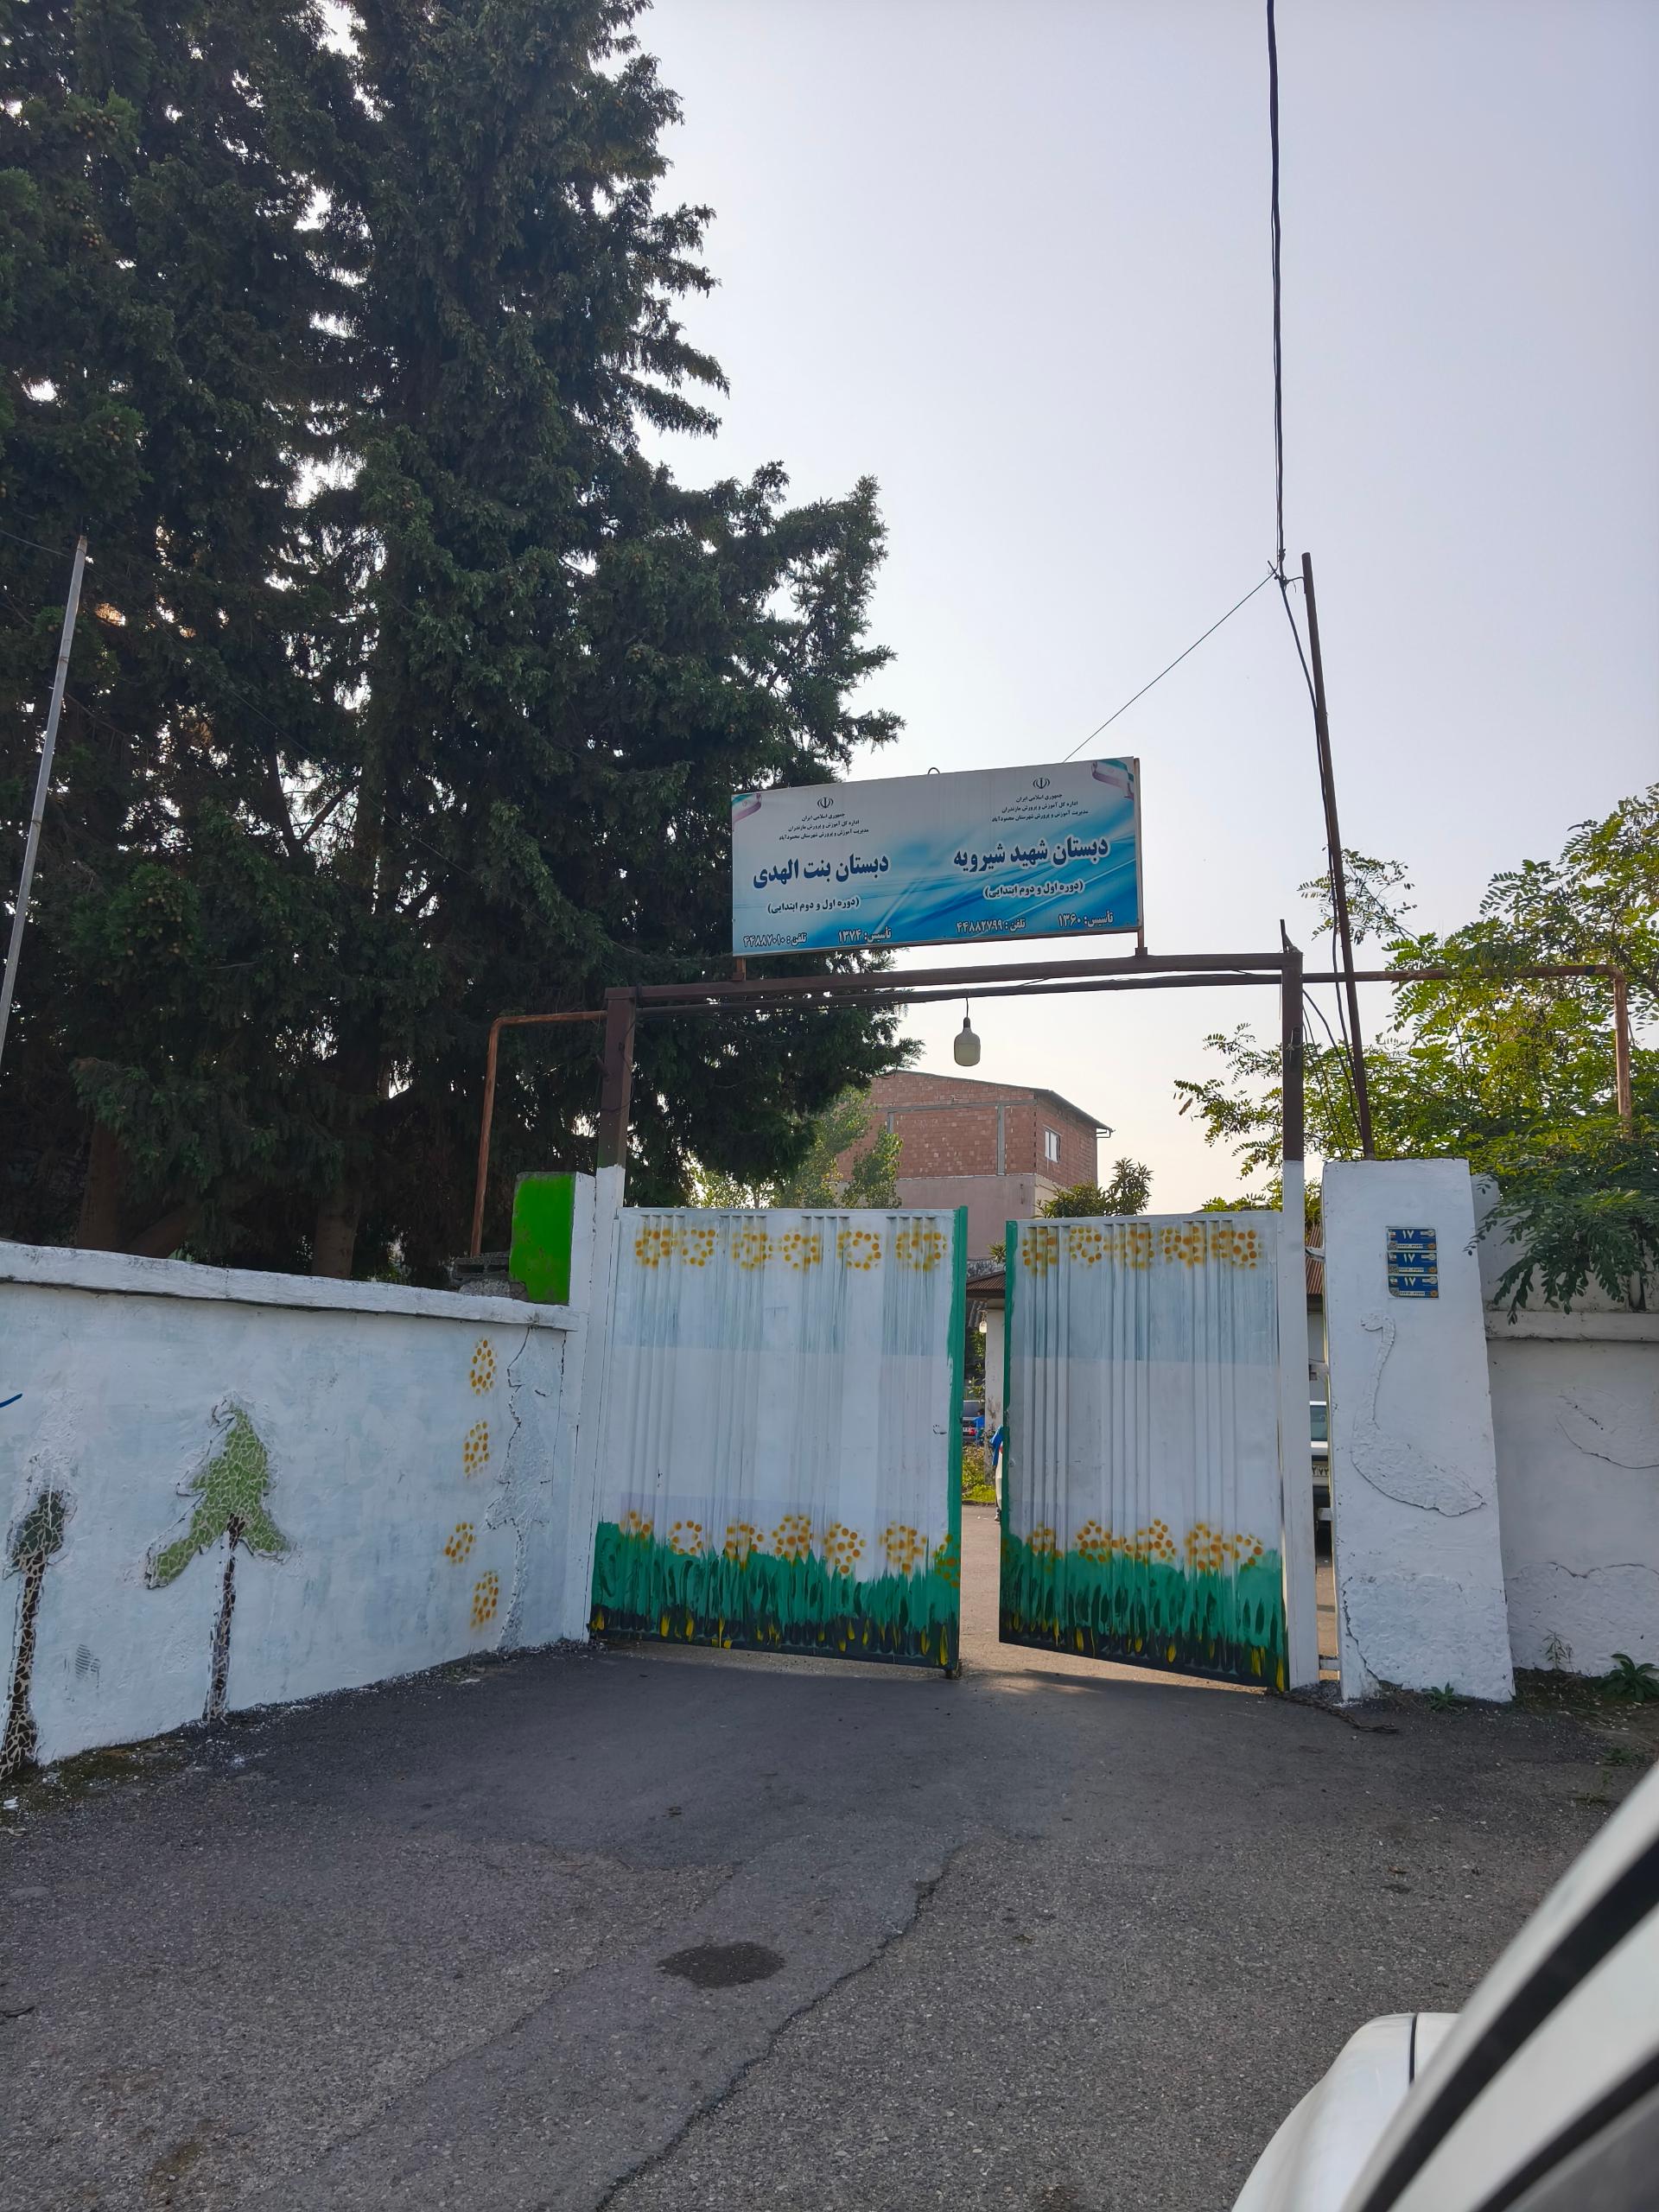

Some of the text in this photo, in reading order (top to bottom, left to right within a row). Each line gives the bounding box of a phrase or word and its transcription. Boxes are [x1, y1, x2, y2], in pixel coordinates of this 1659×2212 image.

[1041, 801, 1058, 810] آموزش
[1054, 810, 1071, 818] آموزش
[953, 836, 1109, 873] دبستان شهید شیرویه
[753, 853, 889, 889] دبستان بنت الهدی
[984, 880, 1084, 899] (دوره اول و دوم ابتدایی)
[767, 901, 798, 914] ابتدایی)
[799, 901, 814, 912] دوم
[822, 899, 836, 910] اول
[837, 896, 860, 908] (دوره
[1058, 912, 1082, 927] ۱۳۶۰
[838, 928, 862, 943] ۱۳۷۴
[1402, 1230, 1414, 1239] ۱۷
[1403, 1253, 1415, 1263] ۱۷
[1404, 1276, 1416, 1287] ۱۷
